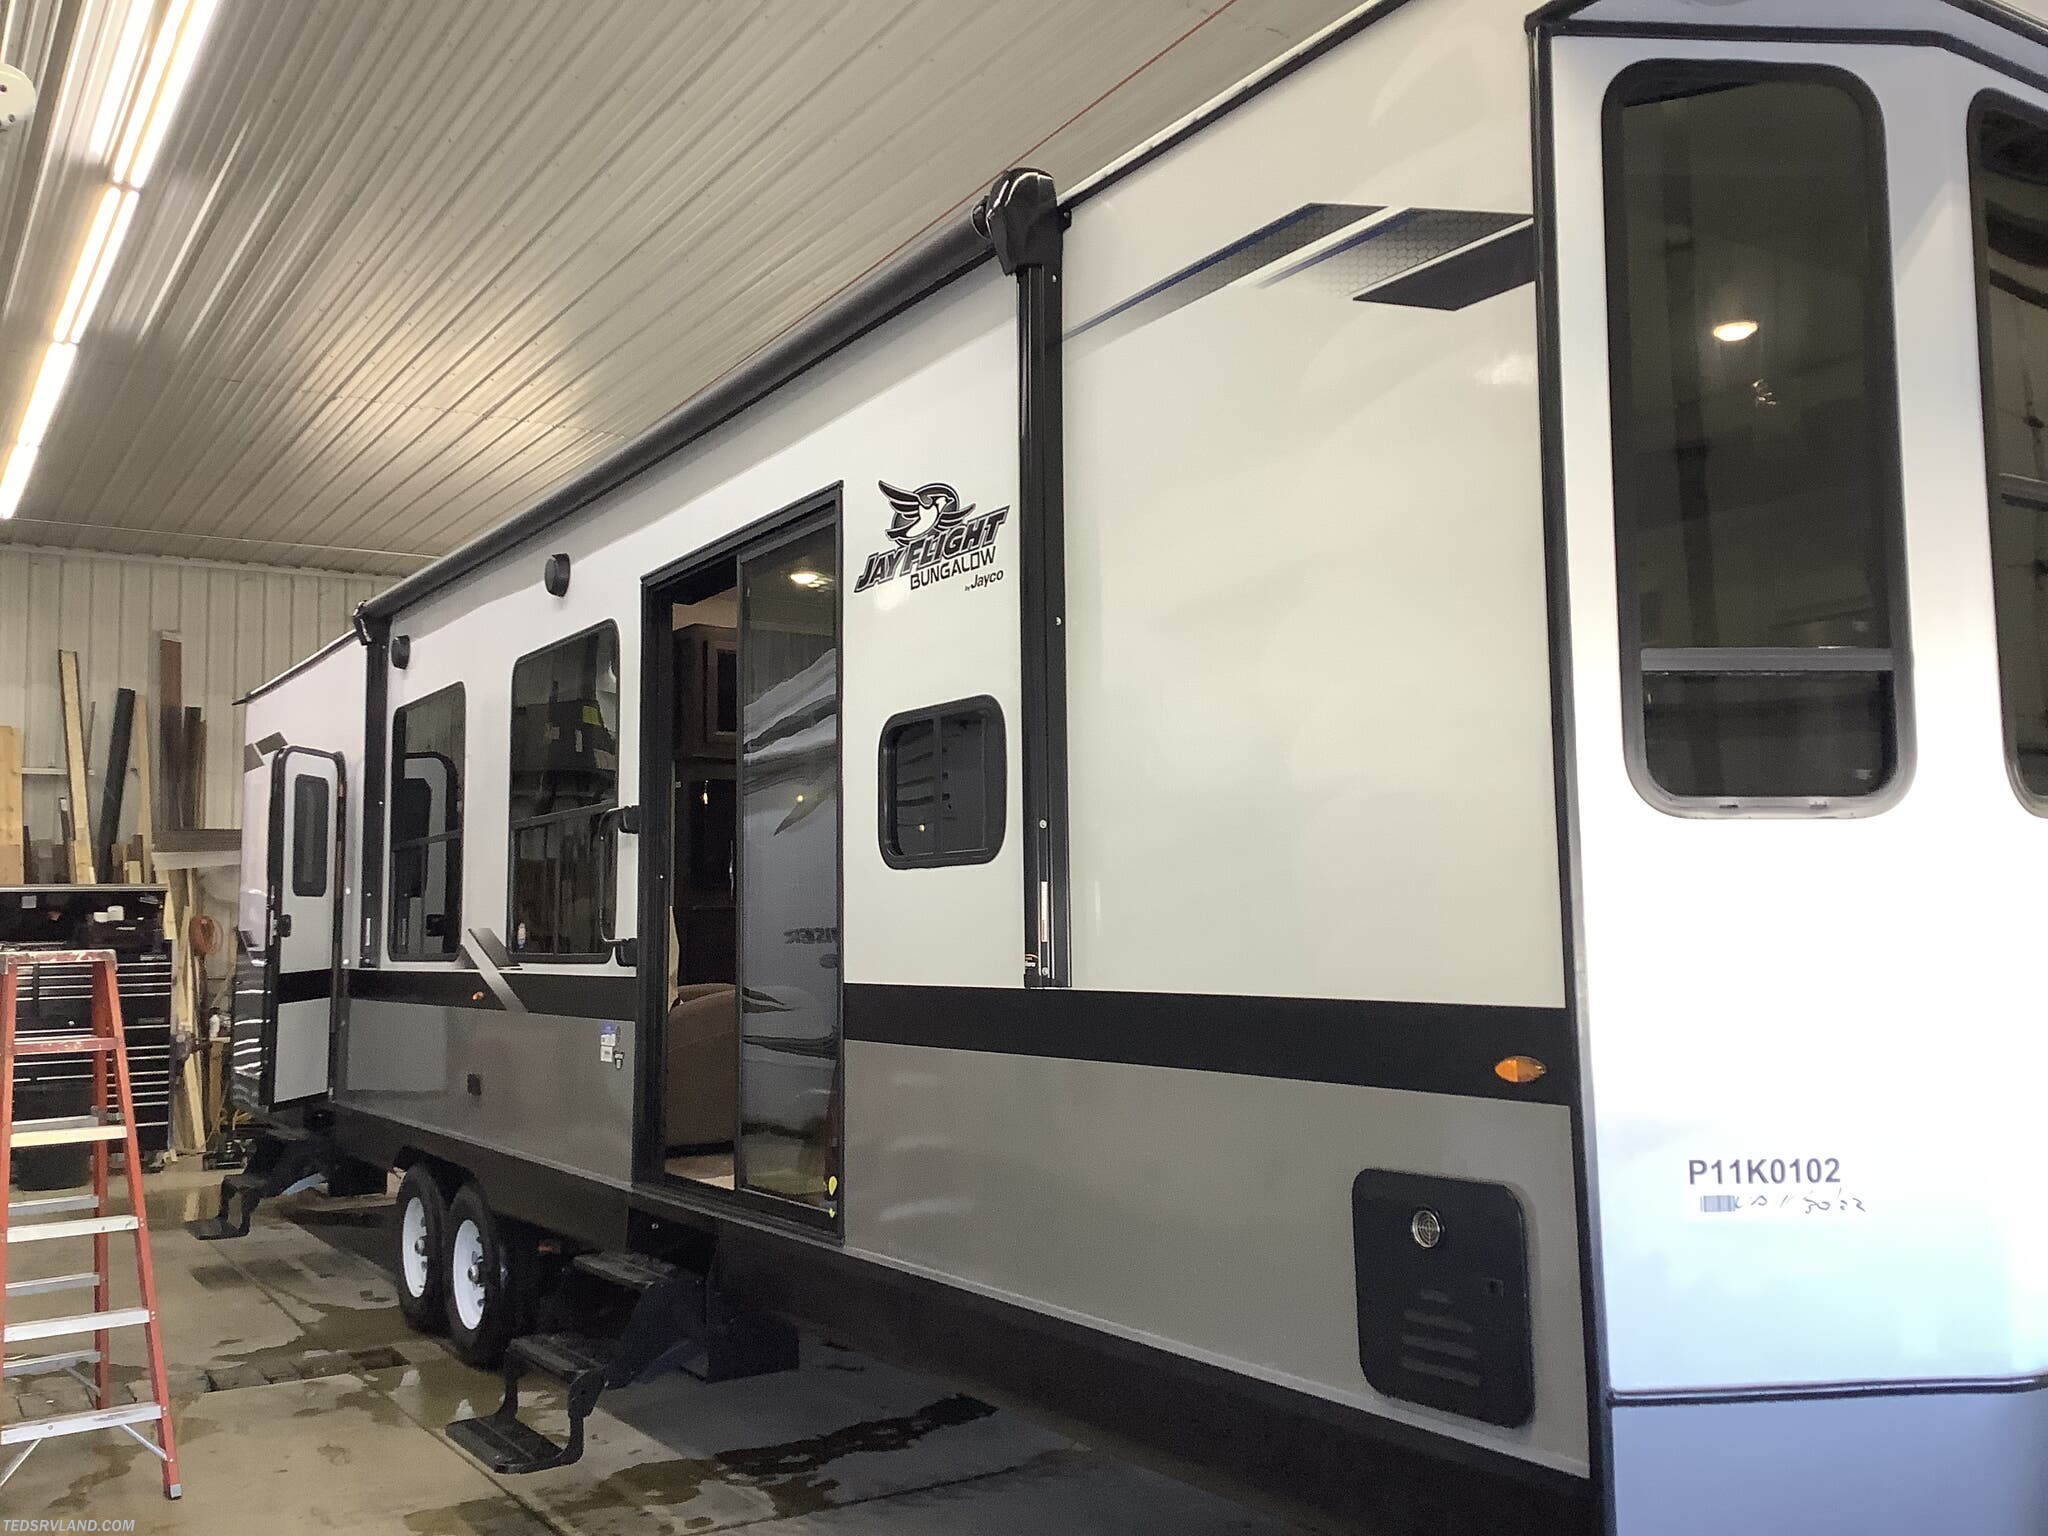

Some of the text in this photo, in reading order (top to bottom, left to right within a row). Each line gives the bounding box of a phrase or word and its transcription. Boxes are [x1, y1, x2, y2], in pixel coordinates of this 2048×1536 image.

[854, 505, 1010, 593] JAY FLIGHT
[910, 546, 996, 590] BUNGALOW
[970, 570, 1004, 589] Jayco
[1688, 1158, 1841, 1185] P11K0102
